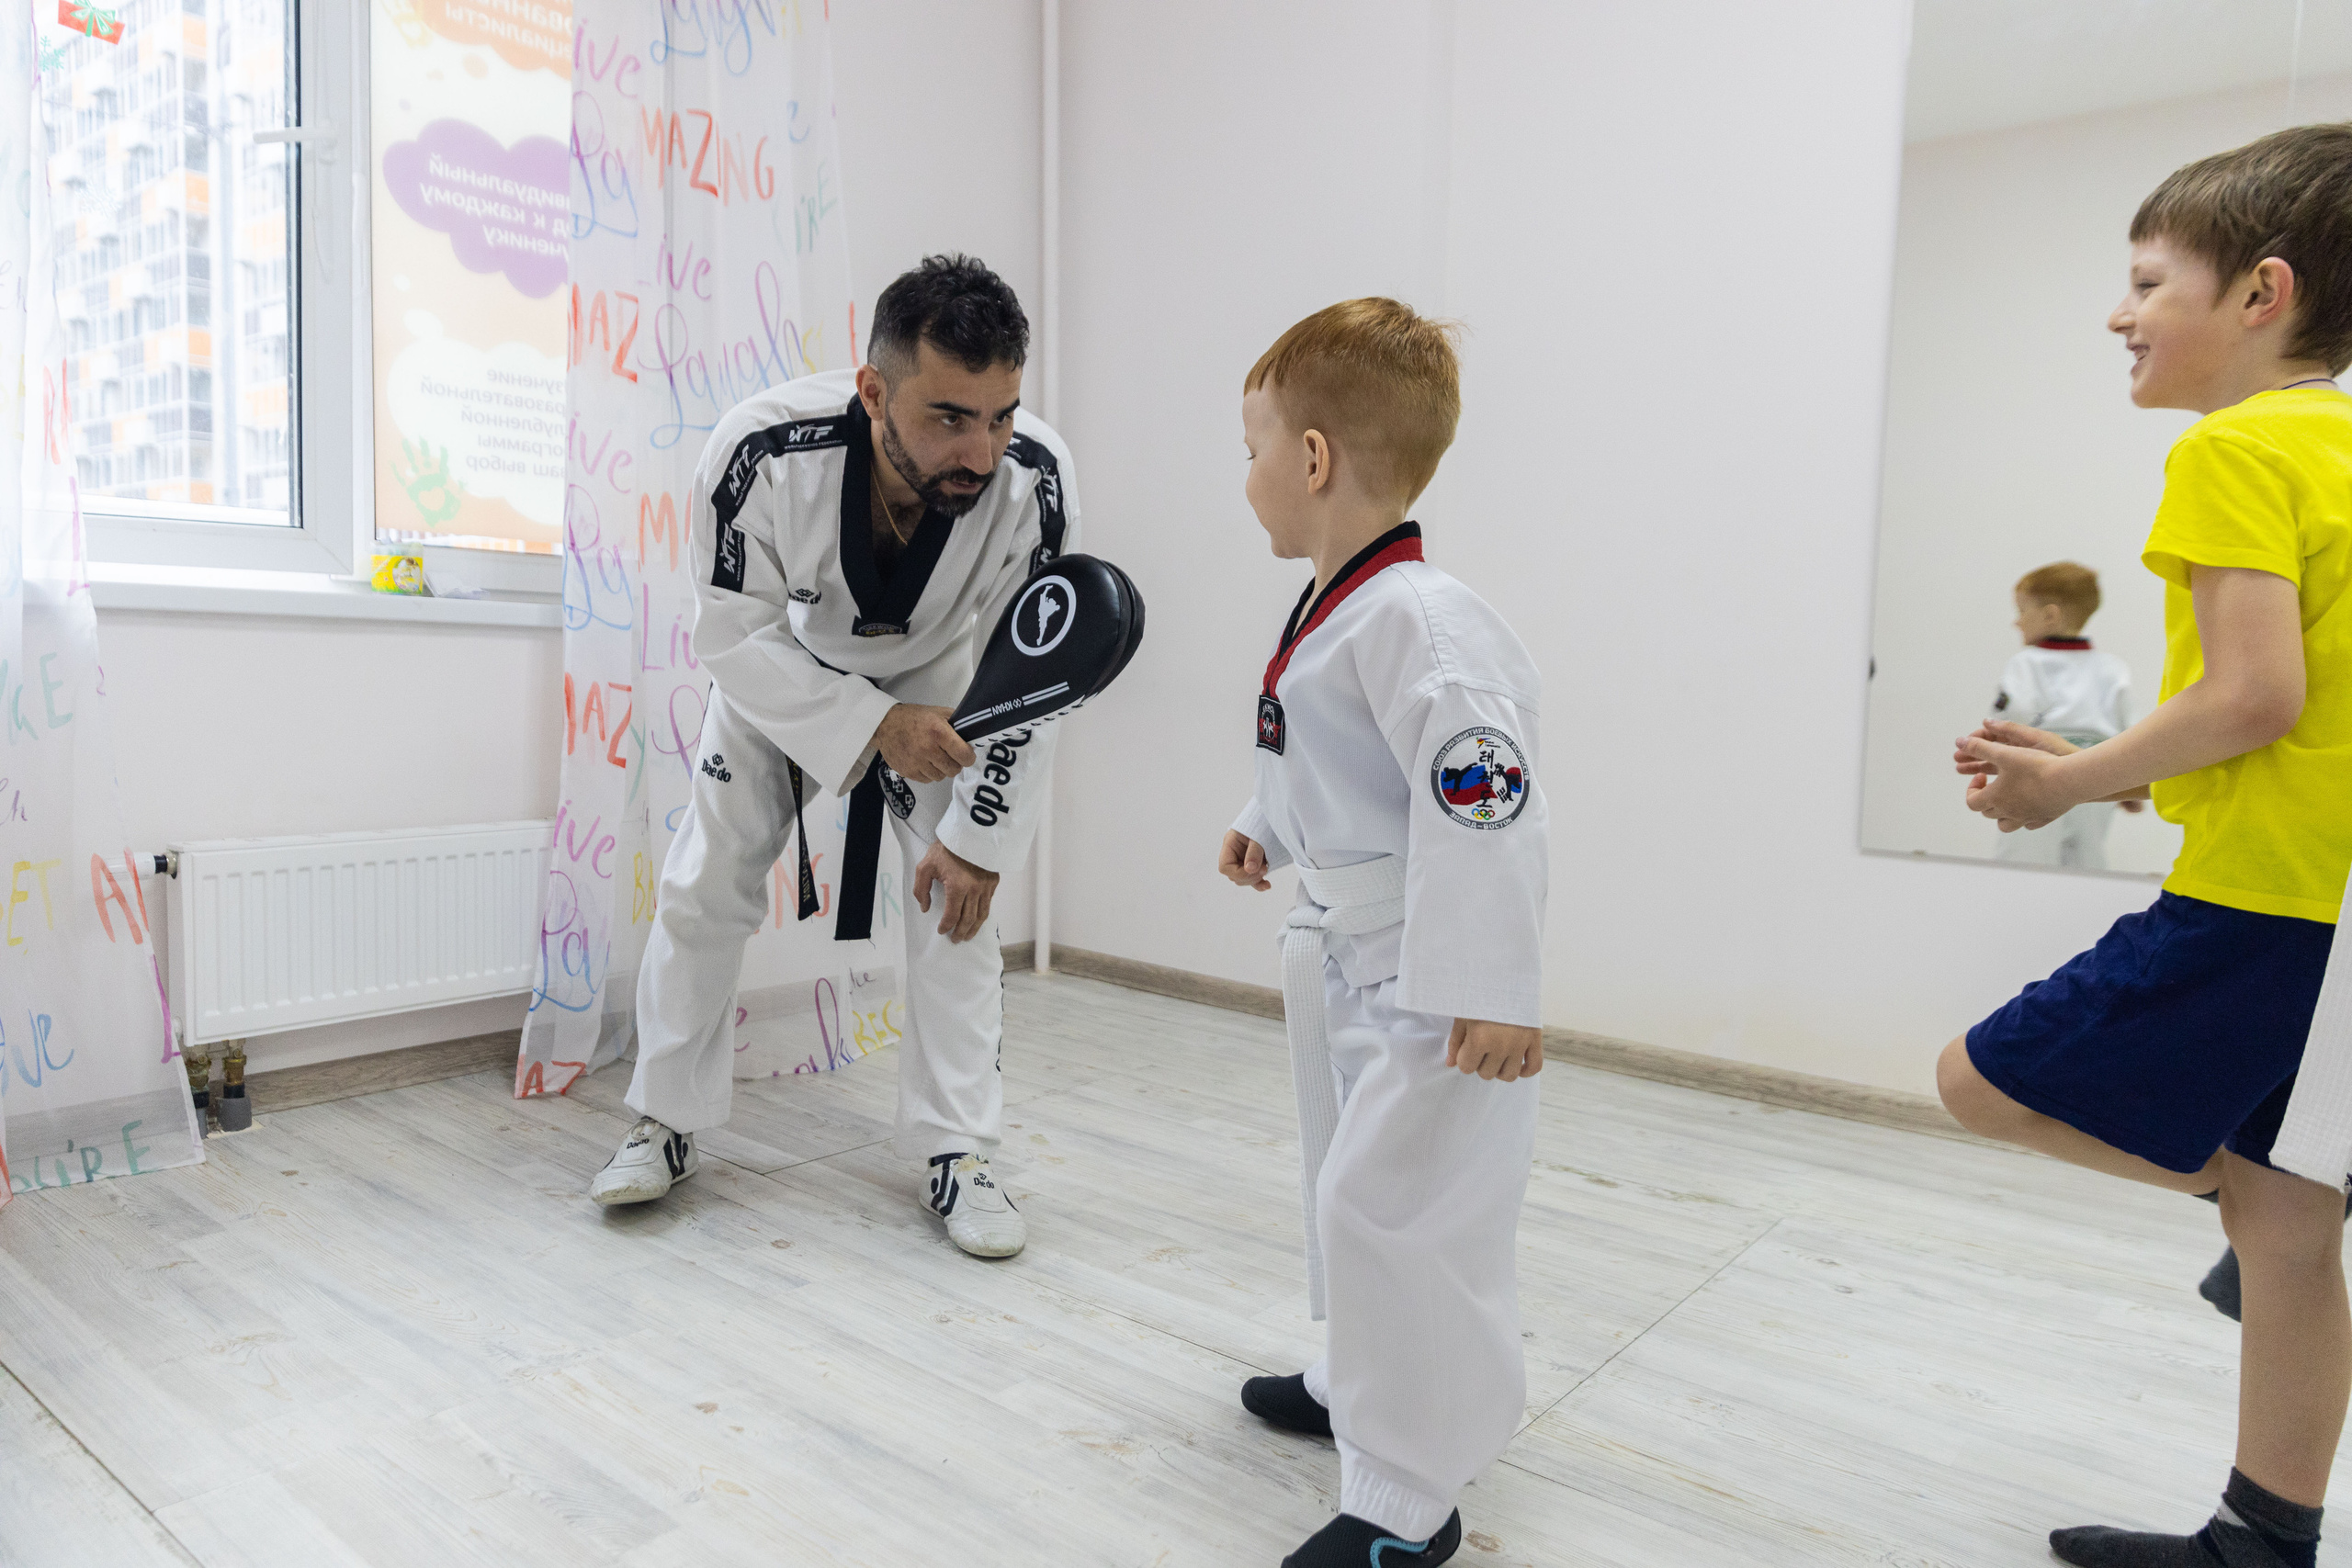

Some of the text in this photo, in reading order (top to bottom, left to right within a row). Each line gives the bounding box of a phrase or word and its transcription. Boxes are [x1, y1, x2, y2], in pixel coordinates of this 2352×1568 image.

[788, 423, 834, 443] WTF
[719, 522, 738, 574] WTF
[991, 700, 1013, 716] KHAN
[1433, 749, 1448, 771] СОЮЗ
[1446, 728, 1484, 750] РАЗВИТИЯ
[701, 758, 731, 783] Daedo
